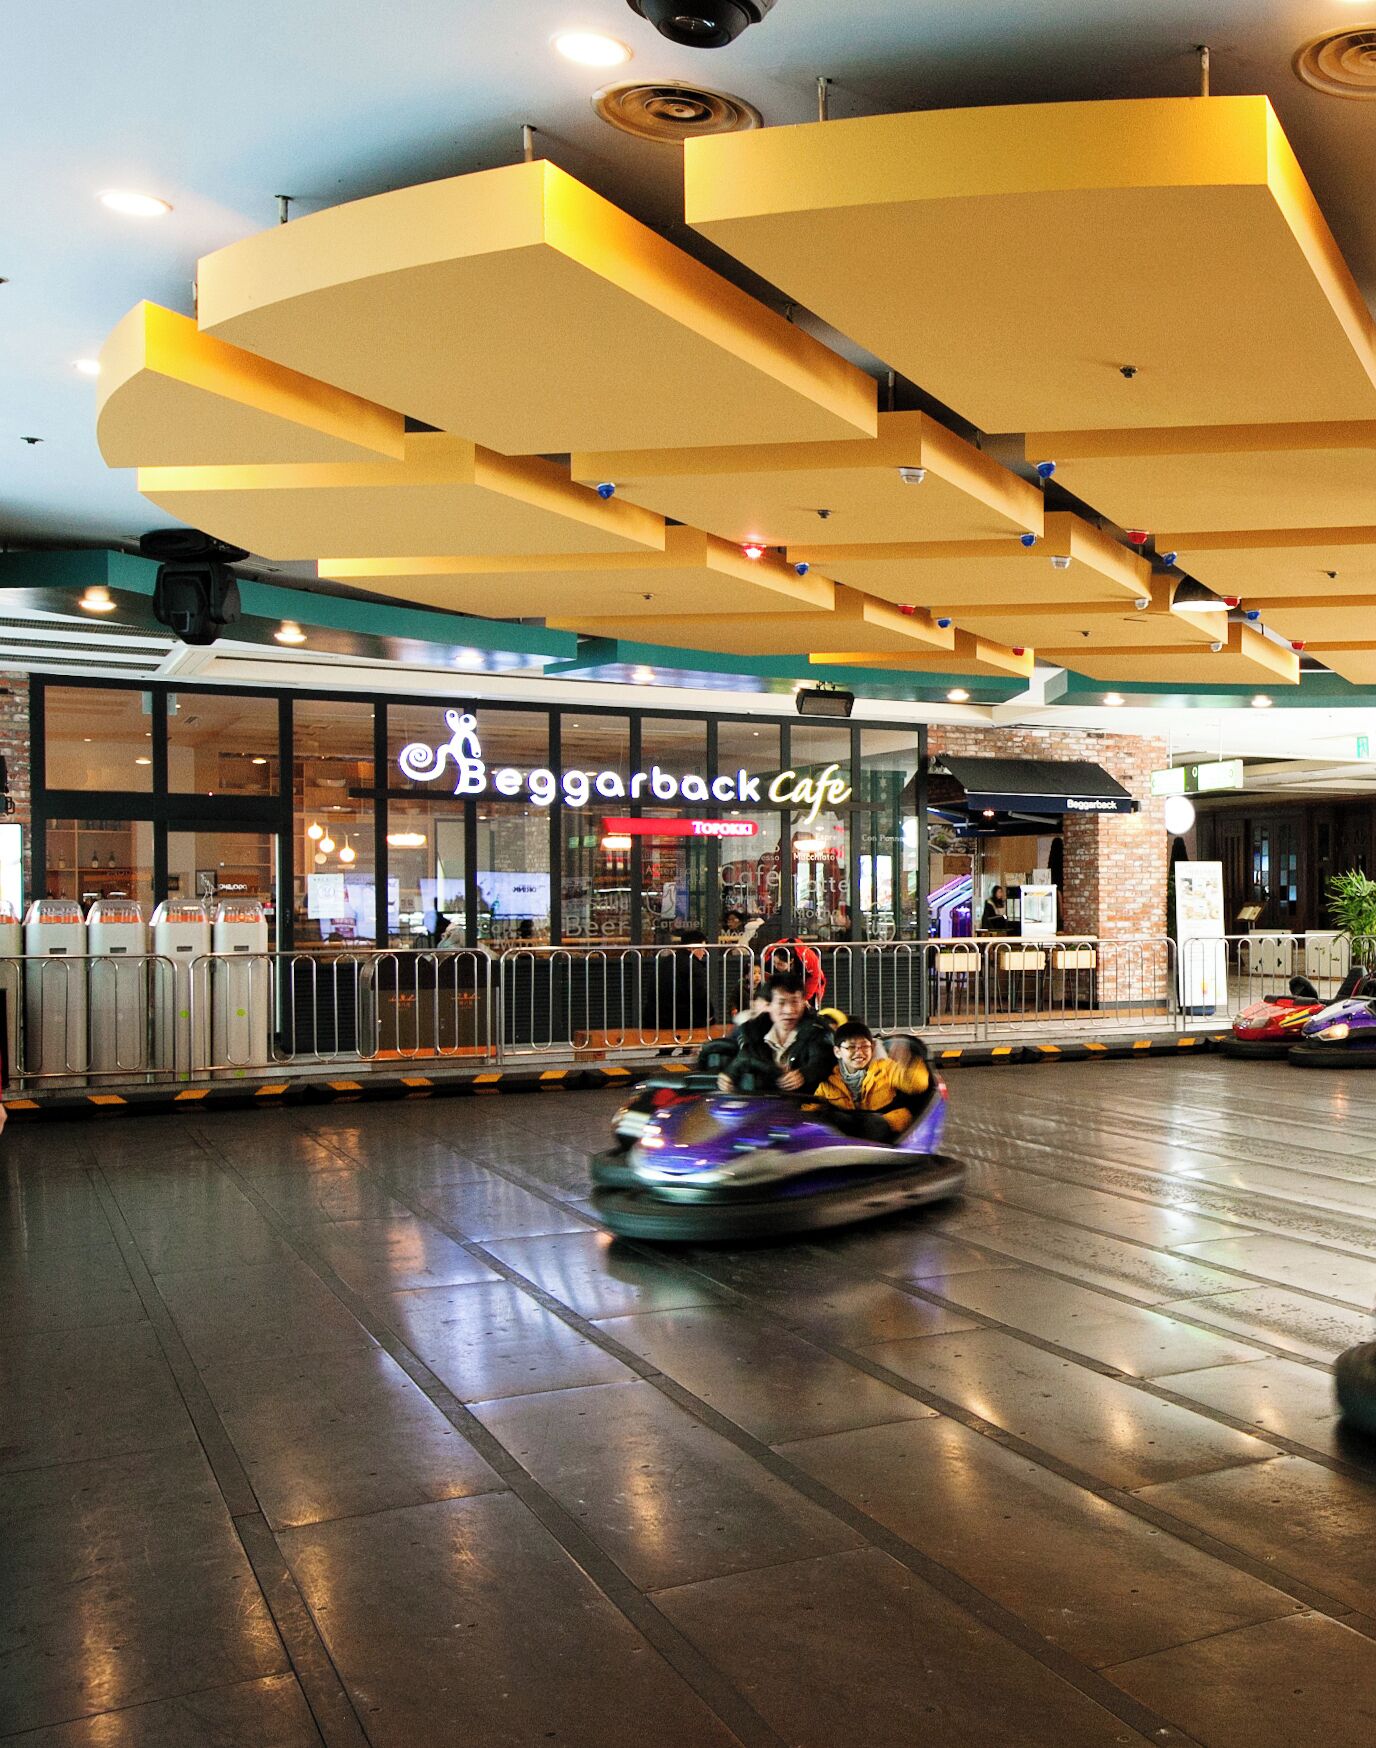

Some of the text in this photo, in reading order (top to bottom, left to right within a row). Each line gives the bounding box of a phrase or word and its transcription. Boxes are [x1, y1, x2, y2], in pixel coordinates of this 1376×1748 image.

[454, 756, 853, 825] Beggarback Cafe
[1066, 799, 1117, 810] Beggarback
[692, 820, 753, 836] TOPOKKI
[720, 864, 780, 887] Café
[565, 915, 630, 936] Beer
